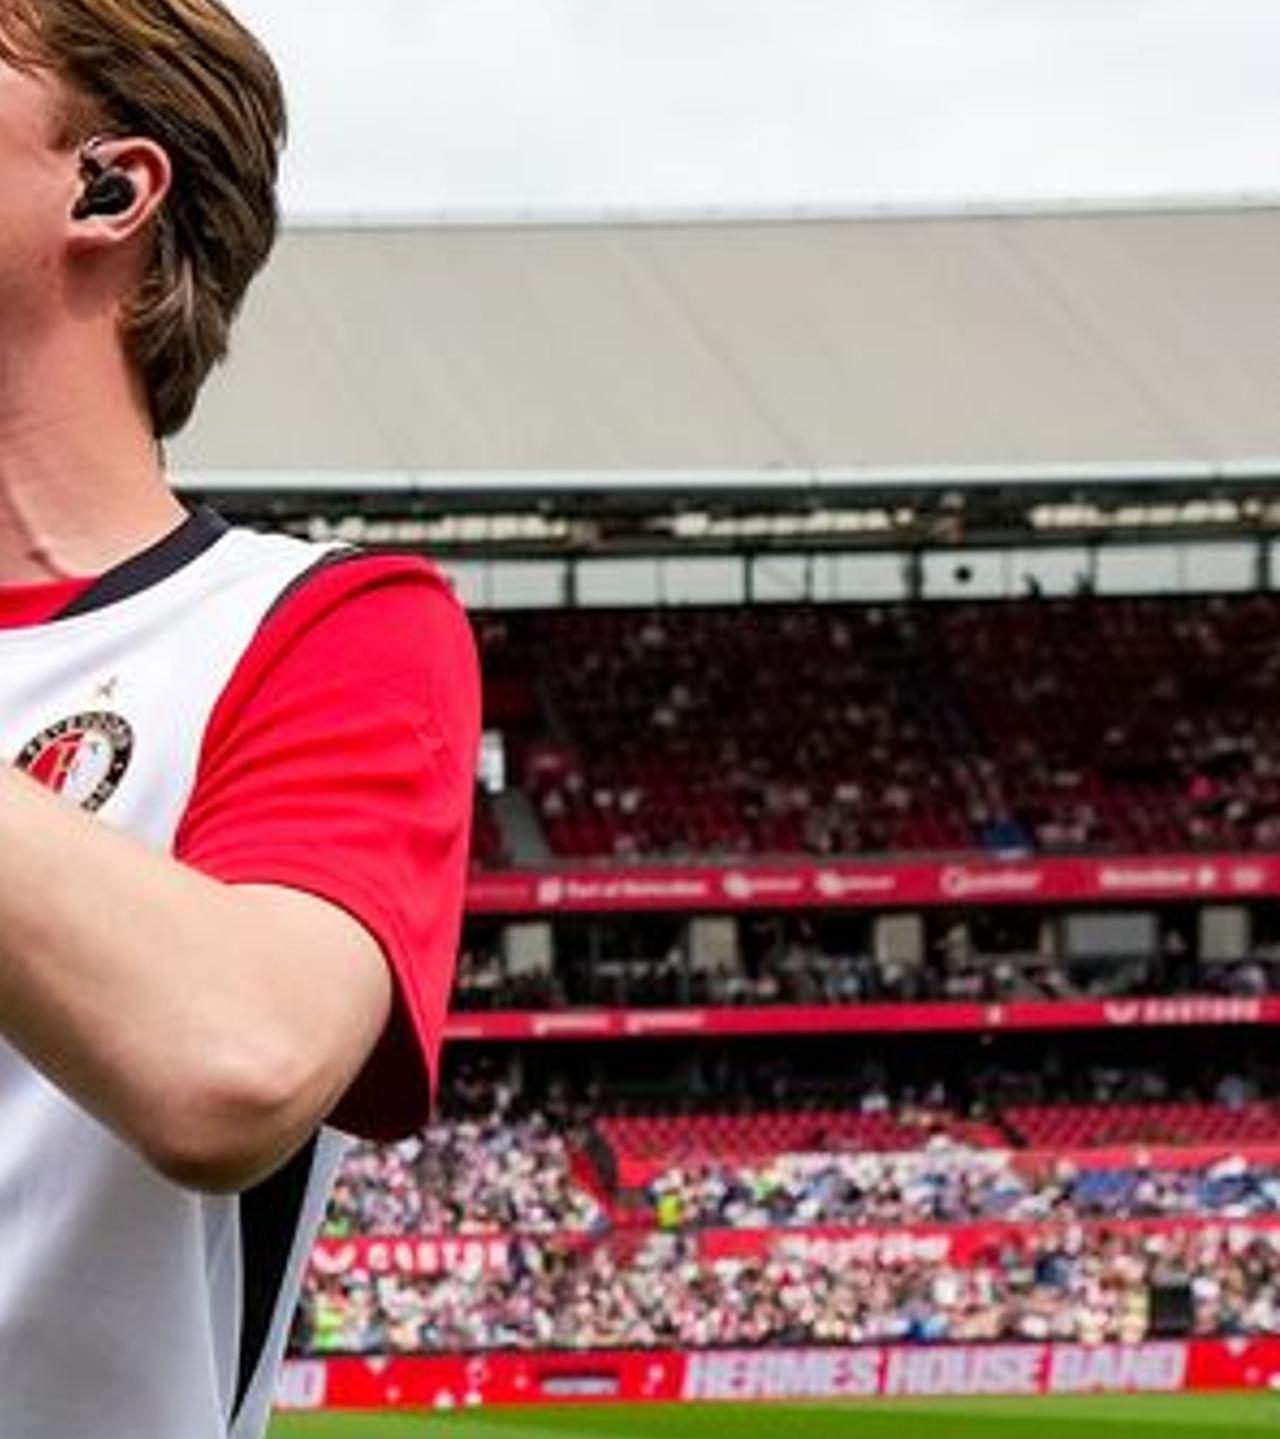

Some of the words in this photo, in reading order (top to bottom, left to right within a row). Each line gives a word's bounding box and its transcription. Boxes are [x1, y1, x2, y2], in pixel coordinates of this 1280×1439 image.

[685, 1348, 877, 1400] HERMES
[886, 1345, 1043, 1396] HOUSE
[1051, 1342, 1184, 1392] BAND
